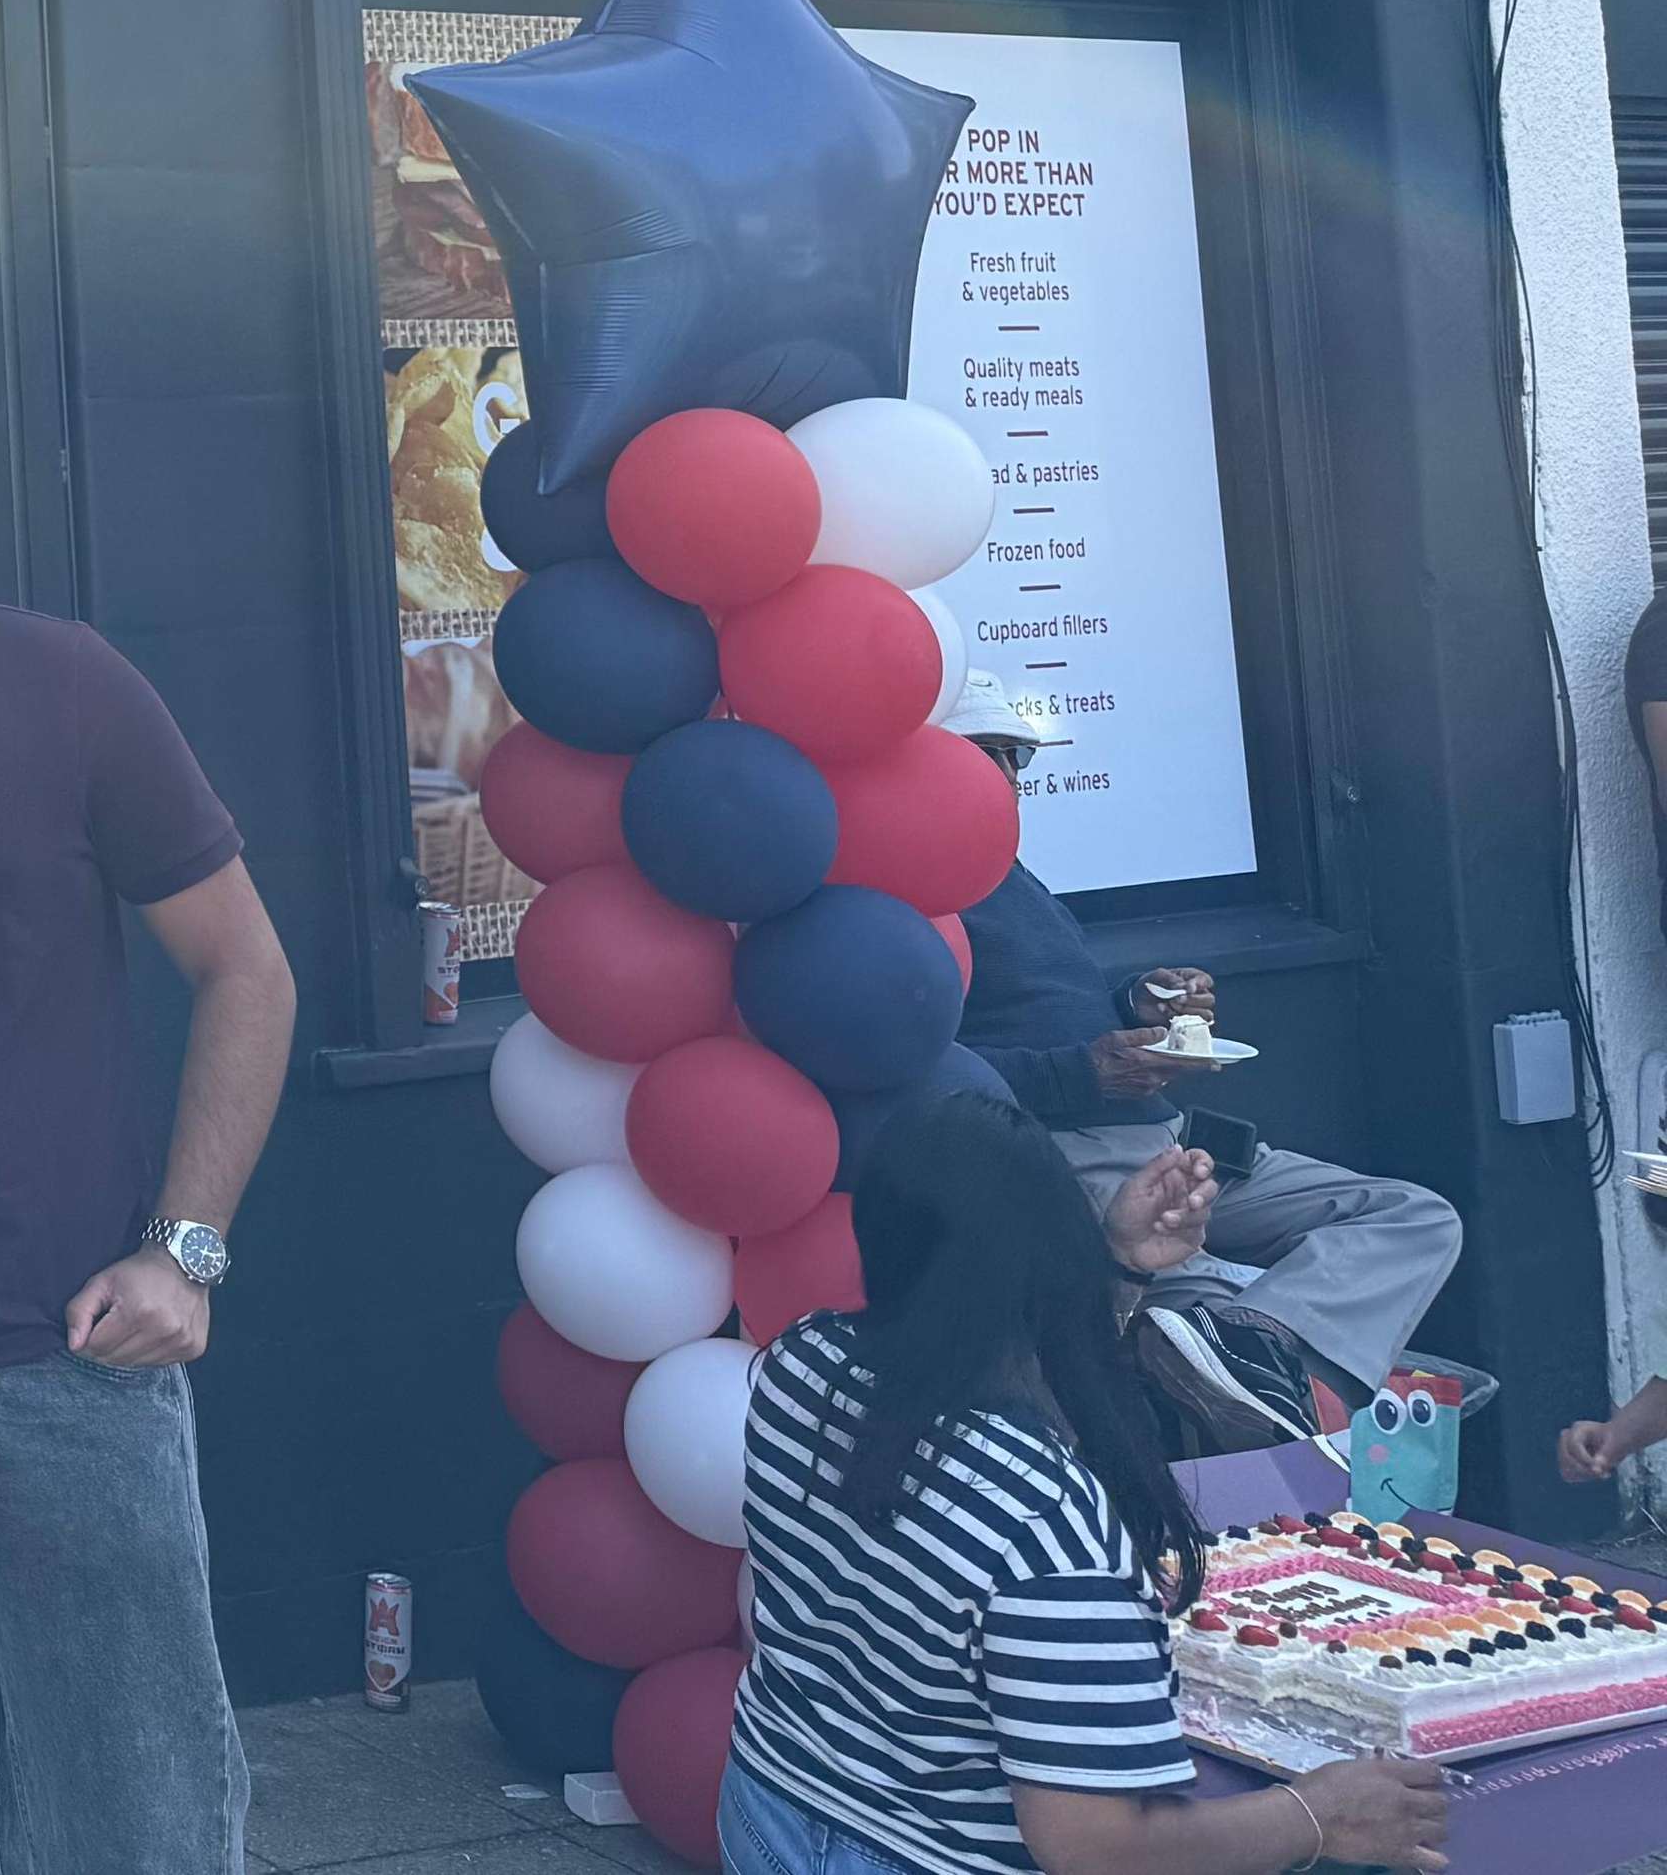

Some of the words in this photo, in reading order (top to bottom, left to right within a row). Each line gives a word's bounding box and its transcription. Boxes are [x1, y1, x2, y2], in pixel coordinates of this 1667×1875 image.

[968, 129, 1010, 153] POP
[1018, 129, 1040, 153] IN
[966, 160, 1028, 185] MORE
[1034, 161, 1094, 186] THAN
[934, 191, 997, 216] YOU'D
[1004, 192, 1085, 217] EXPECT
[970, 251, 1015, 273] Fresh
[1020, 251, 1057, 273] fruit
[962, 281, 974, 302] &
[979, 280, 1070, 306] vegetables
[963, 357, 1023, 383] Quality
[1029, 356, 1080, 377] meats
[965, 386, 977, 407] &
[982, 385, 1029, 411] ready
[1035, 385, 1084, 405] meals
[1015, 462, 1028, 484] &
[1033, 460, 1099, 487] pastries
[987, 541, 1044, 563] Frozen
[1049, 536, 1086, 559] food
[977, 615, 1058, 645] Cupboard
[1063, 614, 1108, 636] fillers
[1007, 695, 1043, 718] cks
[1049, 693, 1061, 715] &
[1066, 690, 1116, 714] treats
[1015, 778, 1041, 797] eer
[1046, 773, 1058, 795] &
[1063, 769, 1110, 792] wines
